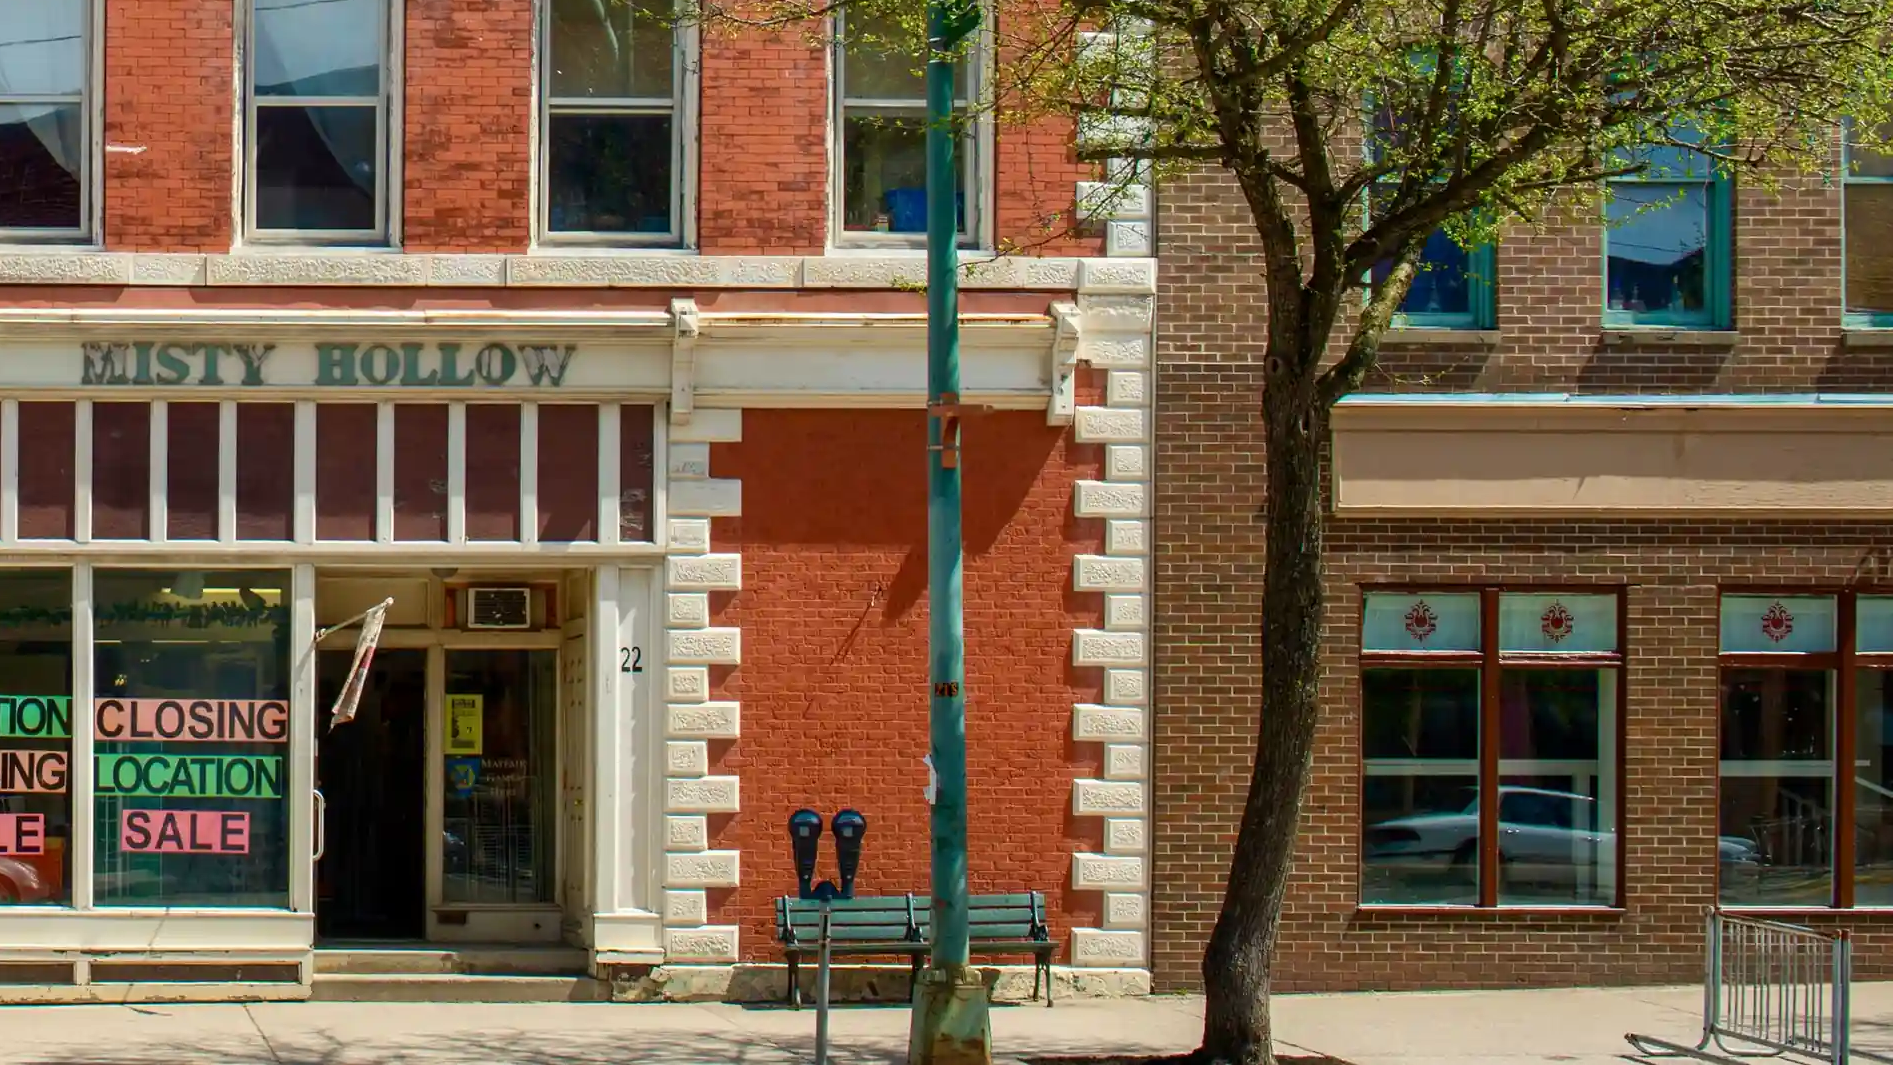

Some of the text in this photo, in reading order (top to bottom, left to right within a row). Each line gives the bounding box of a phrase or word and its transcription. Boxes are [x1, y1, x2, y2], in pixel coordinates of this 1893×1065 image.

[80, 341, 577, 387] MISTY HOLLOW
[620, 646, 643, 672] 22
[96, 699, 287, 740] CLOSING
[94, 755, 281, 796] LOCATION
[125, 811, 246, 851] SALE
